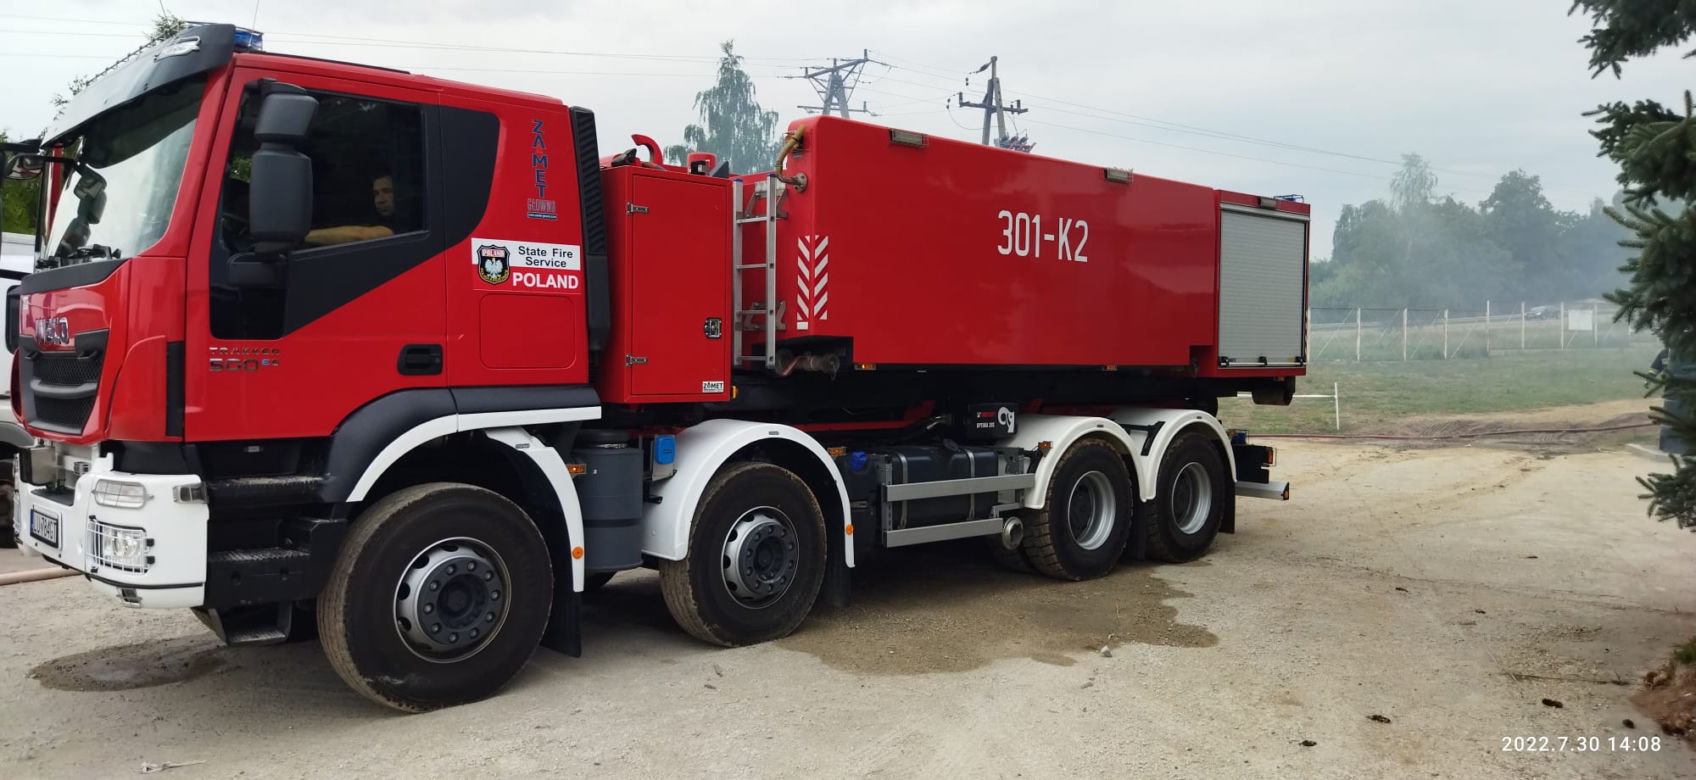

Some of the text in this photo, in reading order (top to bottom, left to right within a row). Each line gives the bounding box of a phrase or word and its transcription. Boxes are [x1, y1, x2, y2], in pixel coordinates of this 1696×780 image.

[532, 119, 548, 198] ZAMET
[997, 209, 1089, 263] 301-K2
[518, 245, 574, 259] State Fire
[525, 256, 567, 268] Service
[512, 272, 579, 290] POLAND
